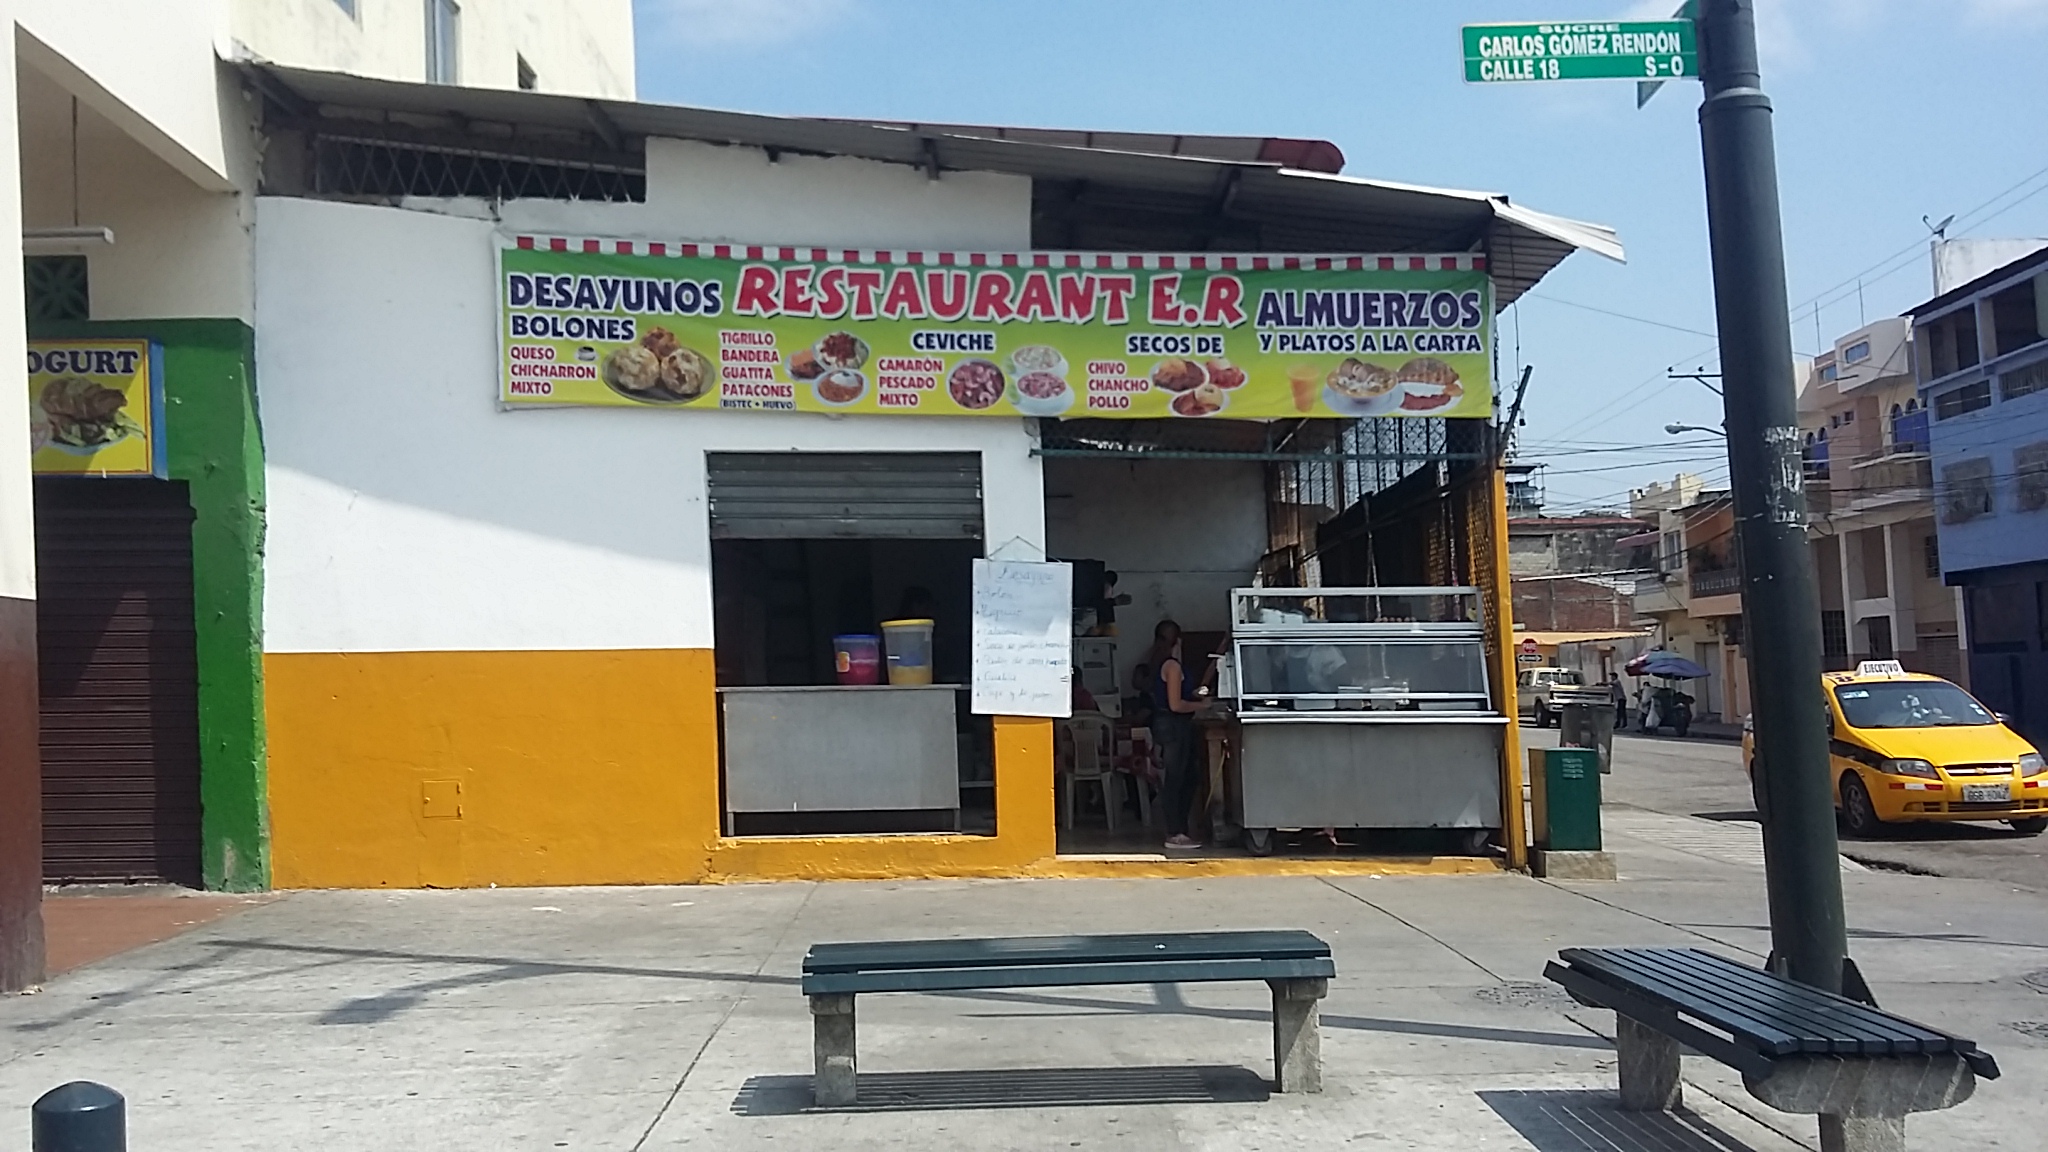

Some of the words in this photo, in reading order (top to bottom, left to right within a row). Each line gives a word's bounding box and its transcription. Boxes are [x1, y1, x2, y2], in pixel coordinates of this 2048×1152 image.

[1538, 24, 1620, 34] SUCRE
[1479, 35, 1545, 57] CARLOS
[1549, 32, 1608, 55] GÓMEZ
[1612, 30, 1681, 54] RENDÓN
[1480, 59, 1534, 80] CALLE
[1539, 59, 1560, 78] 18
[510, 275, 721, 314] DESAYUNOS
[738, 267, 1133, 322] RESTAURANT
[1150, 275, 1243, 324] E.R
[1257, 291, 1480, 327] ALMUERZOS
[512, 315, 634, 340] BOLONES
[721, 332, 774, 346] TIGRILLO
[913, 332, 994, 351] CEVICHE
[1128, 336, 1190, 353] SECOS
[1197, 336, 1222, 353] DE
[1259, 334, 1272, 351] Y
[1279, 334, 1355, 351] PLATOS
[1359, 334, 1376, 351] A
[1383, 334, 1408, 351] LA
[1414, 334, 1481, 351] CARTA
[511, 347, 555, 360] QUESO
[722, 349, 779, 362] BANDERA
[511, 364, 596, 379] CHICHARRON
[879, 357, 943, 372] CAMARÓN
[1088, 362, 1126, 375] CHIVO
[722, 366, 774, 380] GUATITA
[511, 381, 551, 394] MIXTO
[879, 376, 935, 389] PESCADO
[1088, 379, 1149, 392] CHANCHO
[722, 383, 793, 397] PATACONES
[879, 394, 918, 406] MIXTO
[1089, 396, 1129, 408] POLLO
[1864, 663, 1899, 674] EJECUTIVO
